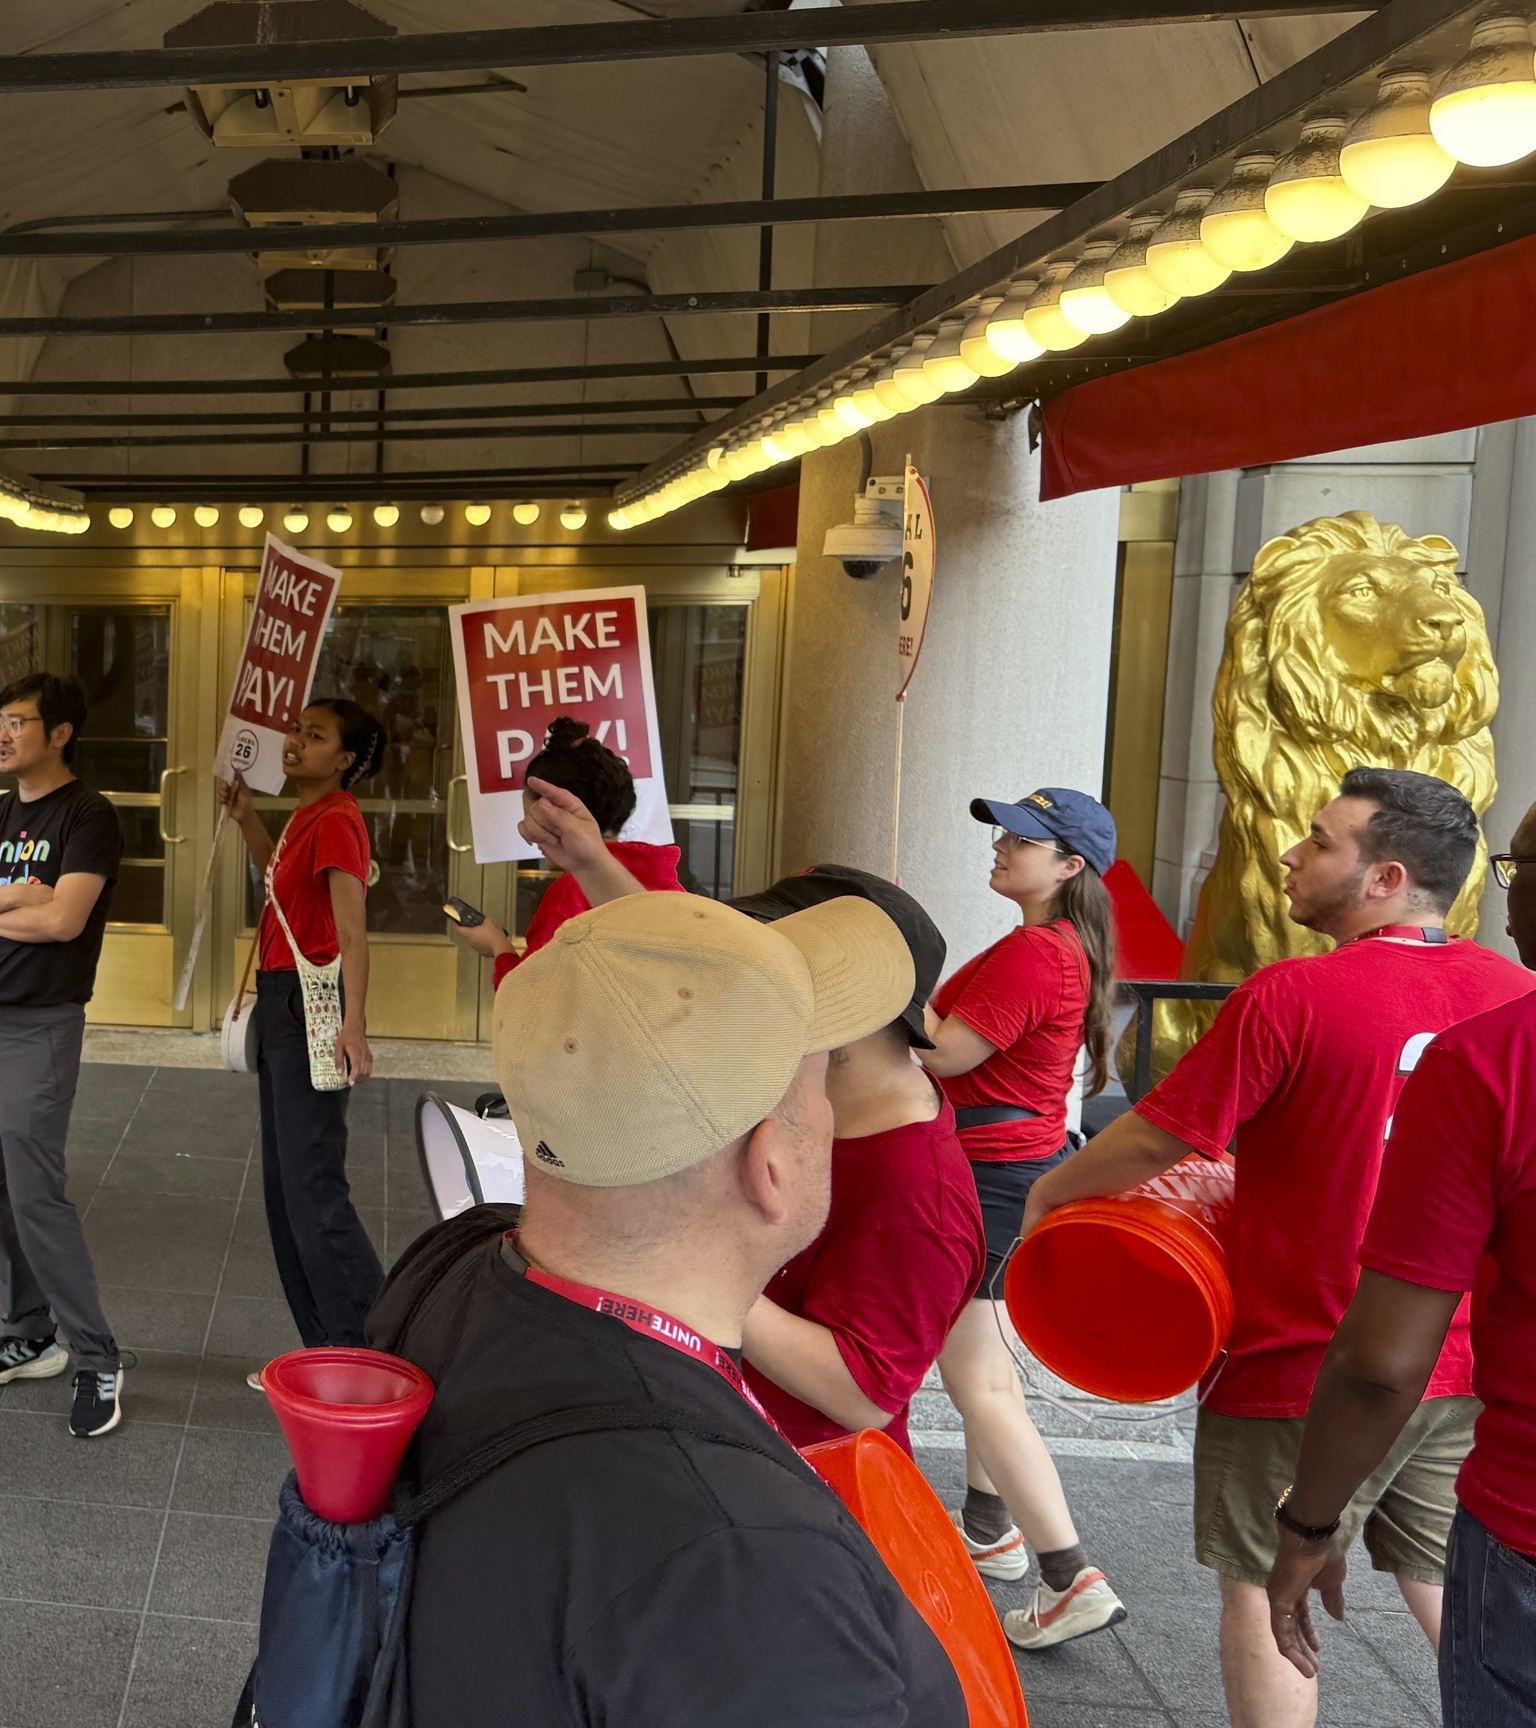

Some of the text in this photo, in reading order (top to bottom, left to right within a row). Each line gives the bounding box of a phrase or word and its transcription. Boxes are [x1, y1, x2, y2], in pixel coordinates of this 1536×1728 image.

[265, 560, 323, 618] MAKE
[254, 609, 307, 662] THEM
[483, 611, 620, 659] MAKE
[236, 660, 295, 723] PAY!
[486, 663, 624, 711] THEM
[235, 743, 252, 759] 26
[496, 719, 631, 780] P!
[595, 1296, 702, 1352] UNITEHERE!
